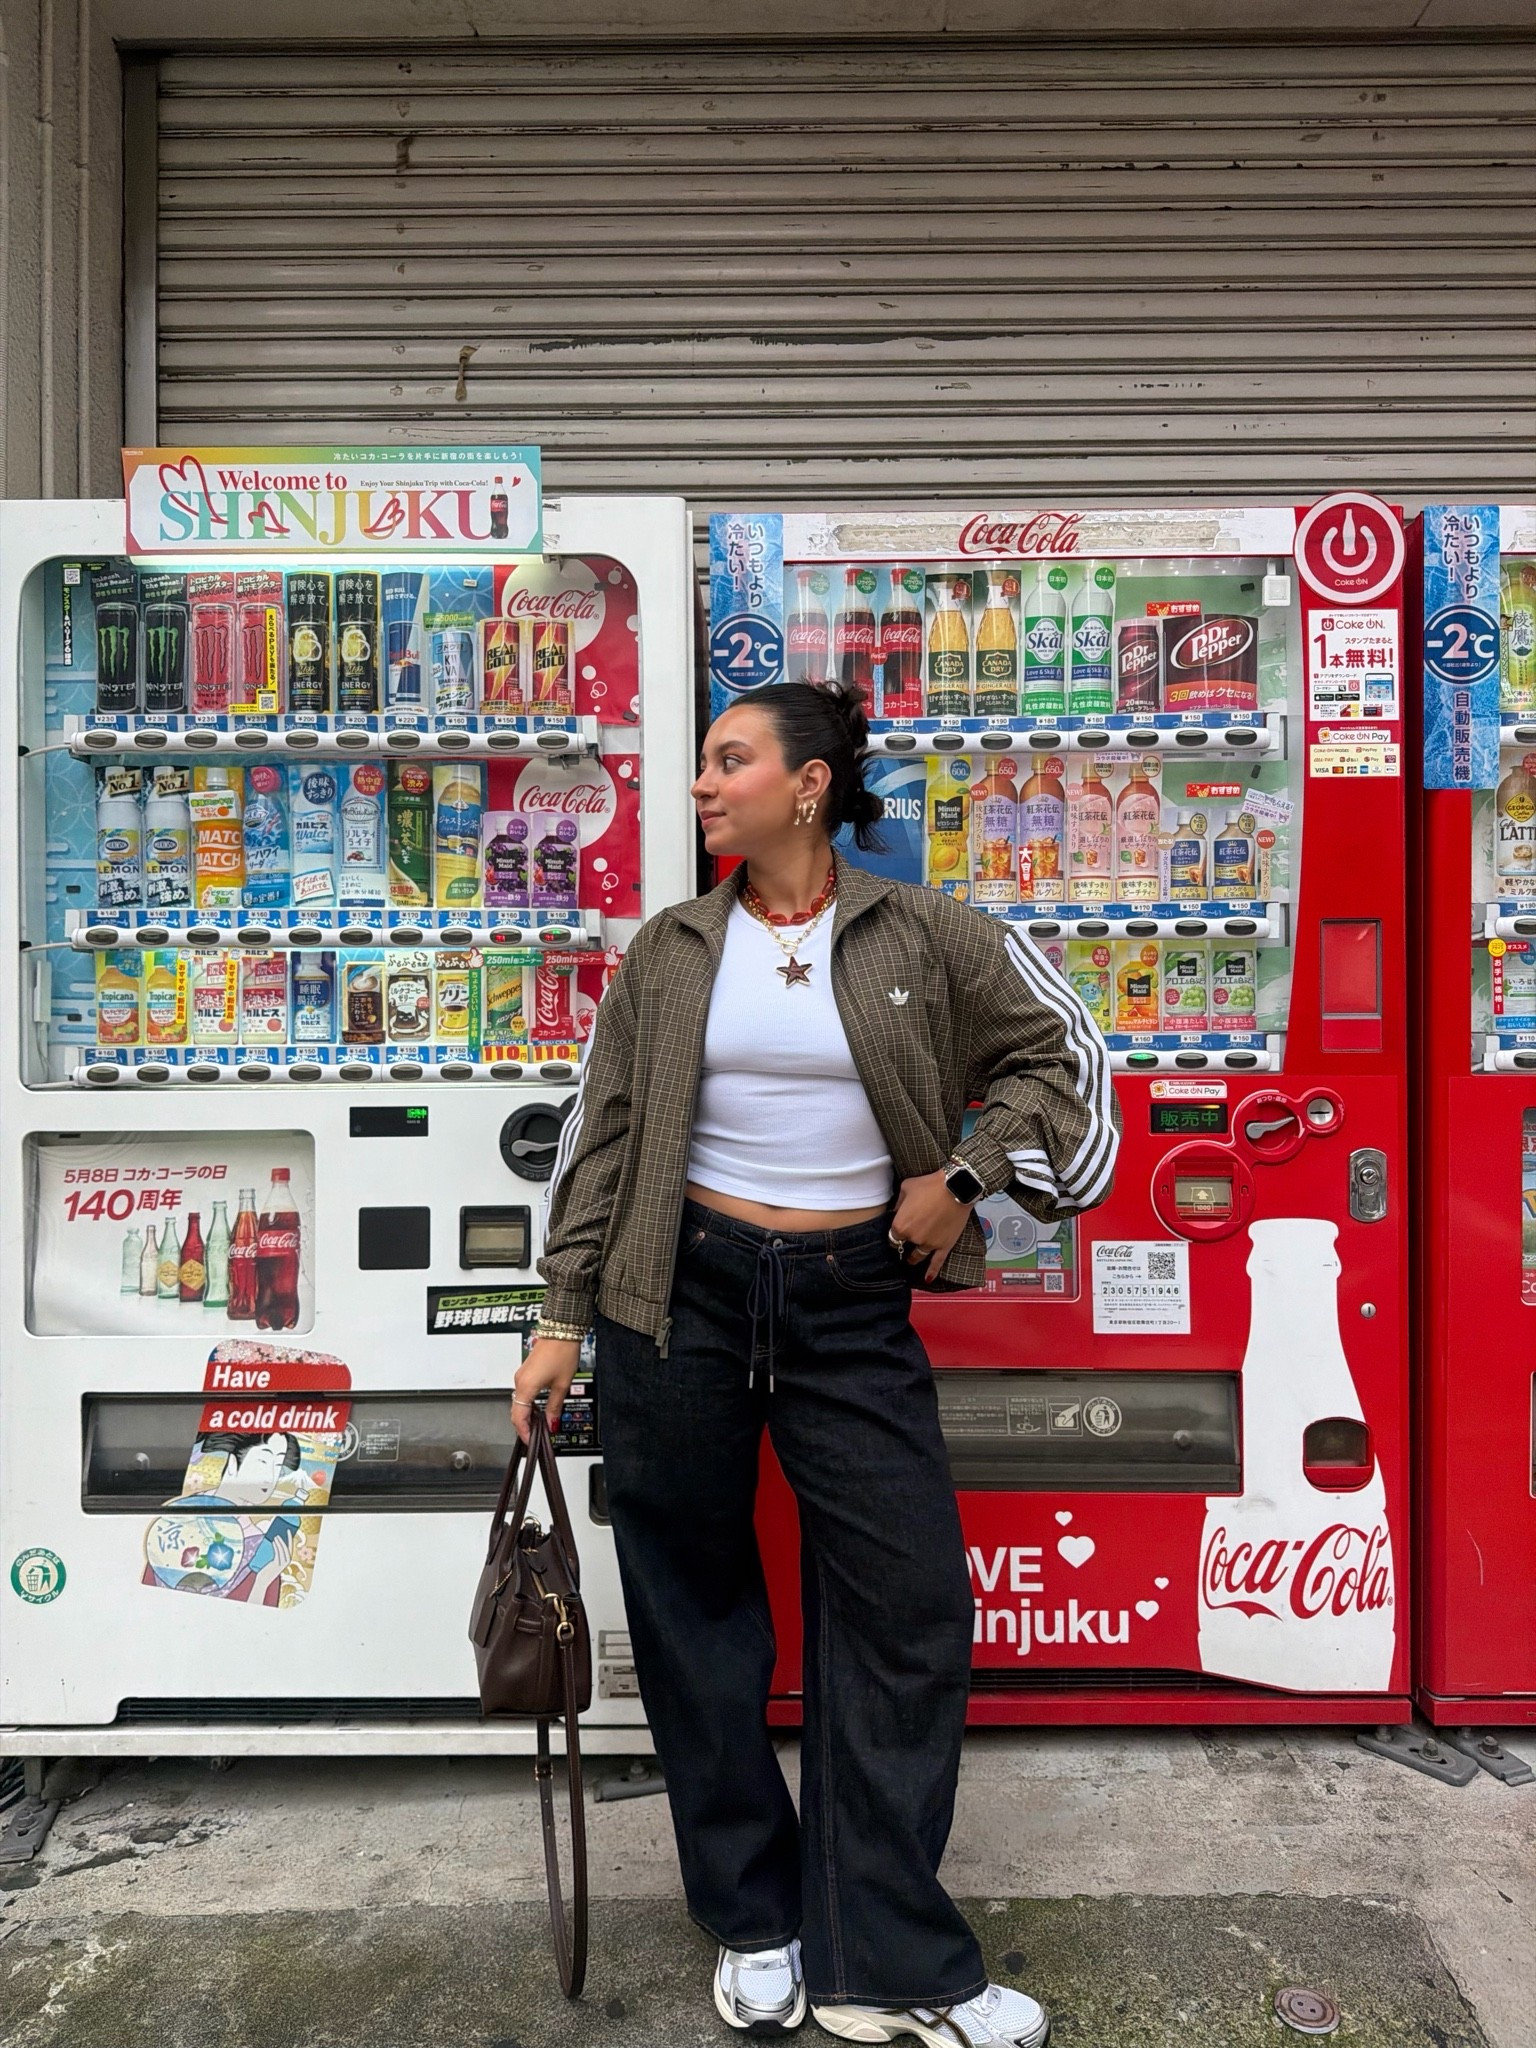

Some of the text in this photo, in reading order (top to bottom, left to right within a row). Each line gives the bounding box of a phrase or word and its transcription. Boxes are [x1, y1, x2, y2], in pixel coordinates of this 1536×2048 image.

[217, 470, 348, 491] Welcome to
[360, 480, 379, 488] Enjoy
[395, 479, 424, 488] Shinjuku
[425, 480, 439, 488] Trip
[159, 490, 496, 546] SHINJUKU
[958, 513, 1086, 555] Coca-Cola
[1443, 515, 1460, 582] 冷たい!
[728, 524, 745, 591] 冷たい!
[1463, 516, 1480, 599] いつもより
[748, 523, 764, 608] いつもより
[290, 579, 327, 592] 冒険心を
[338, 579, 374, 592] 冒険心を
[290, 594, 329, 606] 解き放て。
[338, 594, 378, 606] 解き放て。
[507, 588, 596, 619] Coca-Cola
[1170, 604, 1200, 614] おすすめ
[1336, 618, 1384, 630] Coke ON
[1512, 610, 1532, 647] 綾鷹
[789, 628, 827, 645] Coca-Cola
[836, 628, 874, 645] Coca-Cola
[883, 627, 921, 645] Coca-Cola
[1208, 626, 1229, 643] Dr
[1344, 637, 1393, 645] スタンプたまると
[487, 643, 517, 658] REAL
[535, 643, 566, 659] REAL
[1191, 634, 1241, 662] Pepper
[1313, 634, 1394, 669] 1本無料!
[487, 655, 516, 670] GOLD
[535, 656, 566, 670] GOLD
[934, 659, 965, 669] CANADA
[982, 659, 1012, 667] CANADA
[1121, 651, 1157, 673] Pepper
[293, 681, 322, 689] ENERGY
[341, 681, 370, 689] ENERGY
[884, 701, 919, 709] コカ・コーラ
[1332, 732, 1389, 743] Coke ON Pay
[1454, 691, 1471, 782] 自動販売機
[110, 774, 138, 790] No.1
[158, 774, 187, 790] No.1
[306, 790, 334, 800] すっきり
[1211, 786, 1241, 795] おすすめ
[519, 784, 611, 813] Coca-Cola
[1026, 803, 1060, 814] 紅茶花伝
[438, 815, 480, 829] ジャスミン茶
[985, 816, 1008, 827] 無糖
[1031, 816, 1055, 827] 無糖
[1123, 811, 1156, 821] 紅茶花伝
[296, 822, 328, 830] カルピス
[975, 805, 983, 850] 後味すっきり
[1070, 804, 1078, 849] 後味すっきり
[296, 830, 330, 839] Water
[1218, 848, 1247, 856] 紅茶花伝
[98, 865, 140, 874] LEMON
[147, 865, 188, 874] LEMON
[390, 885, 414, 894] 体脂肪
[979, 882, 1013, 890] すっきり爽やか
[1073, 881, 1109, 889] 後味すっきり
[1121, 881, 1157, 889] 後味すっきり
[977, 889, 1015, 898] アールグレイ
[487, 955, 542, 964] 250ml缶コーナー
[546, 954, 601, 964] 250ml缶コーナー
[1494, 959, 1502, 1011] お手頃価格!
[101, 991, 135, 1003] Tropicana
[487, 985, 523, 1005] Schweppes
[246, 1009, 279, 1017] カルピス
[485, 1046, 527, 1060] 110円
[534, 1046, 578, 1060] 110円
[1169, 1086, 1220, 1096] Coke ON Pay
[1160, 1110, 1218, 1127] 販売中
[63, 1164, 228, 1184] 5月8日 コカ・コーラの日
[63, 1189, 183, 1222] 140周年
[1096, 1245, 1135, 1258] Coca-Cola
[1102, 1286, 1180, 1295] 2305751946
[434, 1304, 543, 1329] 野球観戦に行
[212, 1365, 271, 1388] Have
[209, 1405, 339, 1429] a cold drink
[1202, 1524, 1389, 1620] Coca-Cola
[20, 1589, 60, 1604] リサイクル
[974, 1599, 1130, 1656] injuku
